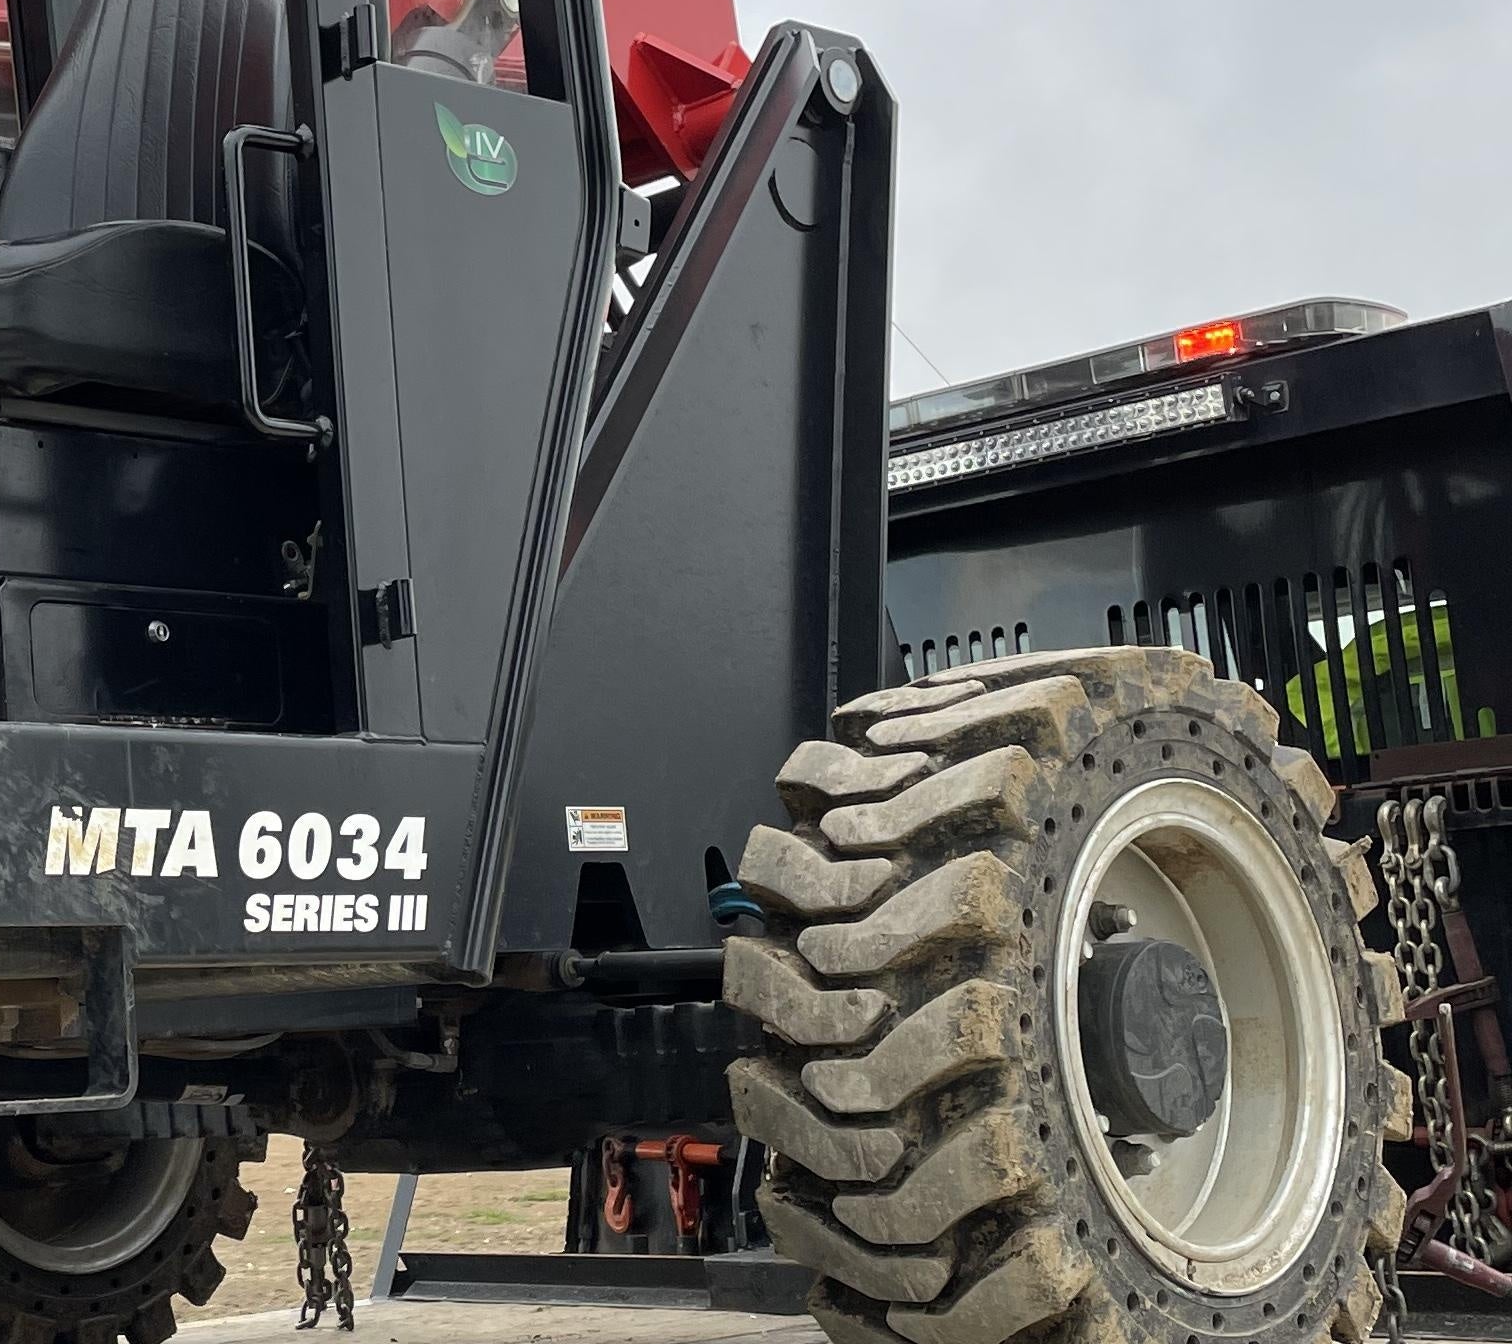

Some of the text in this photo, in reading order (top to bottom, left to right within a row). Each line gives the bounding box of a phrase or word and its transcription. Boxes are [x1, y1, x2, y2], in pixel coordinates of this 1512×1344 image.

[44, 805, 428, 882] MTA 6034
[243, 893, 428, 934] SERIES III
